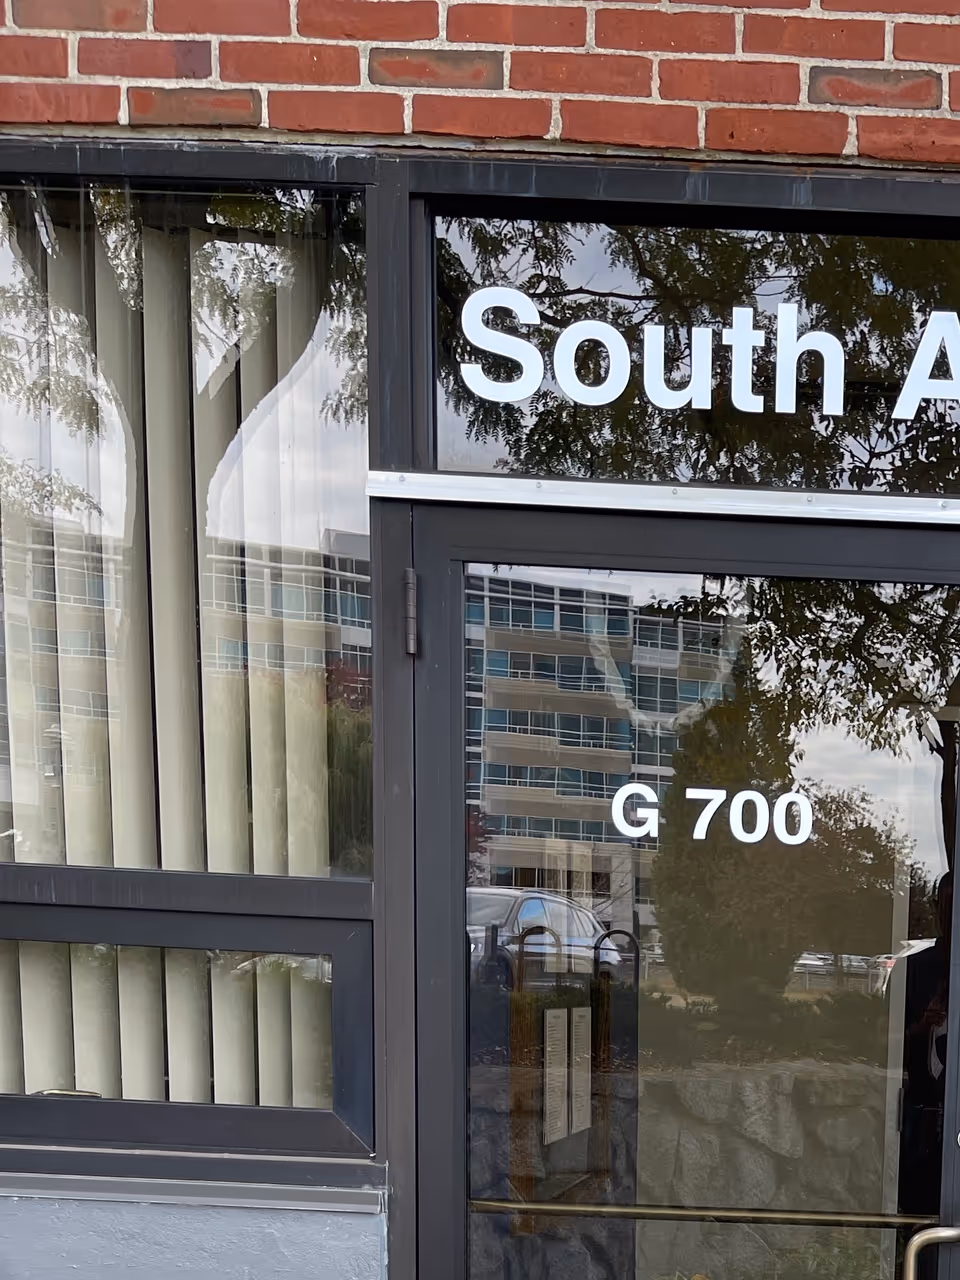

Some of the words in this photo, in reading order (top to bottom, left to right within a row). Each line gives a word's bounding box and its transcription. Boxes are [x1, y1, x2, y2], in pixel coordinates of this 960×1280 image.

[458, 286, 845, 416] South
[610, 783, 659, 838] G
[685, 788, 814, 845] 700
